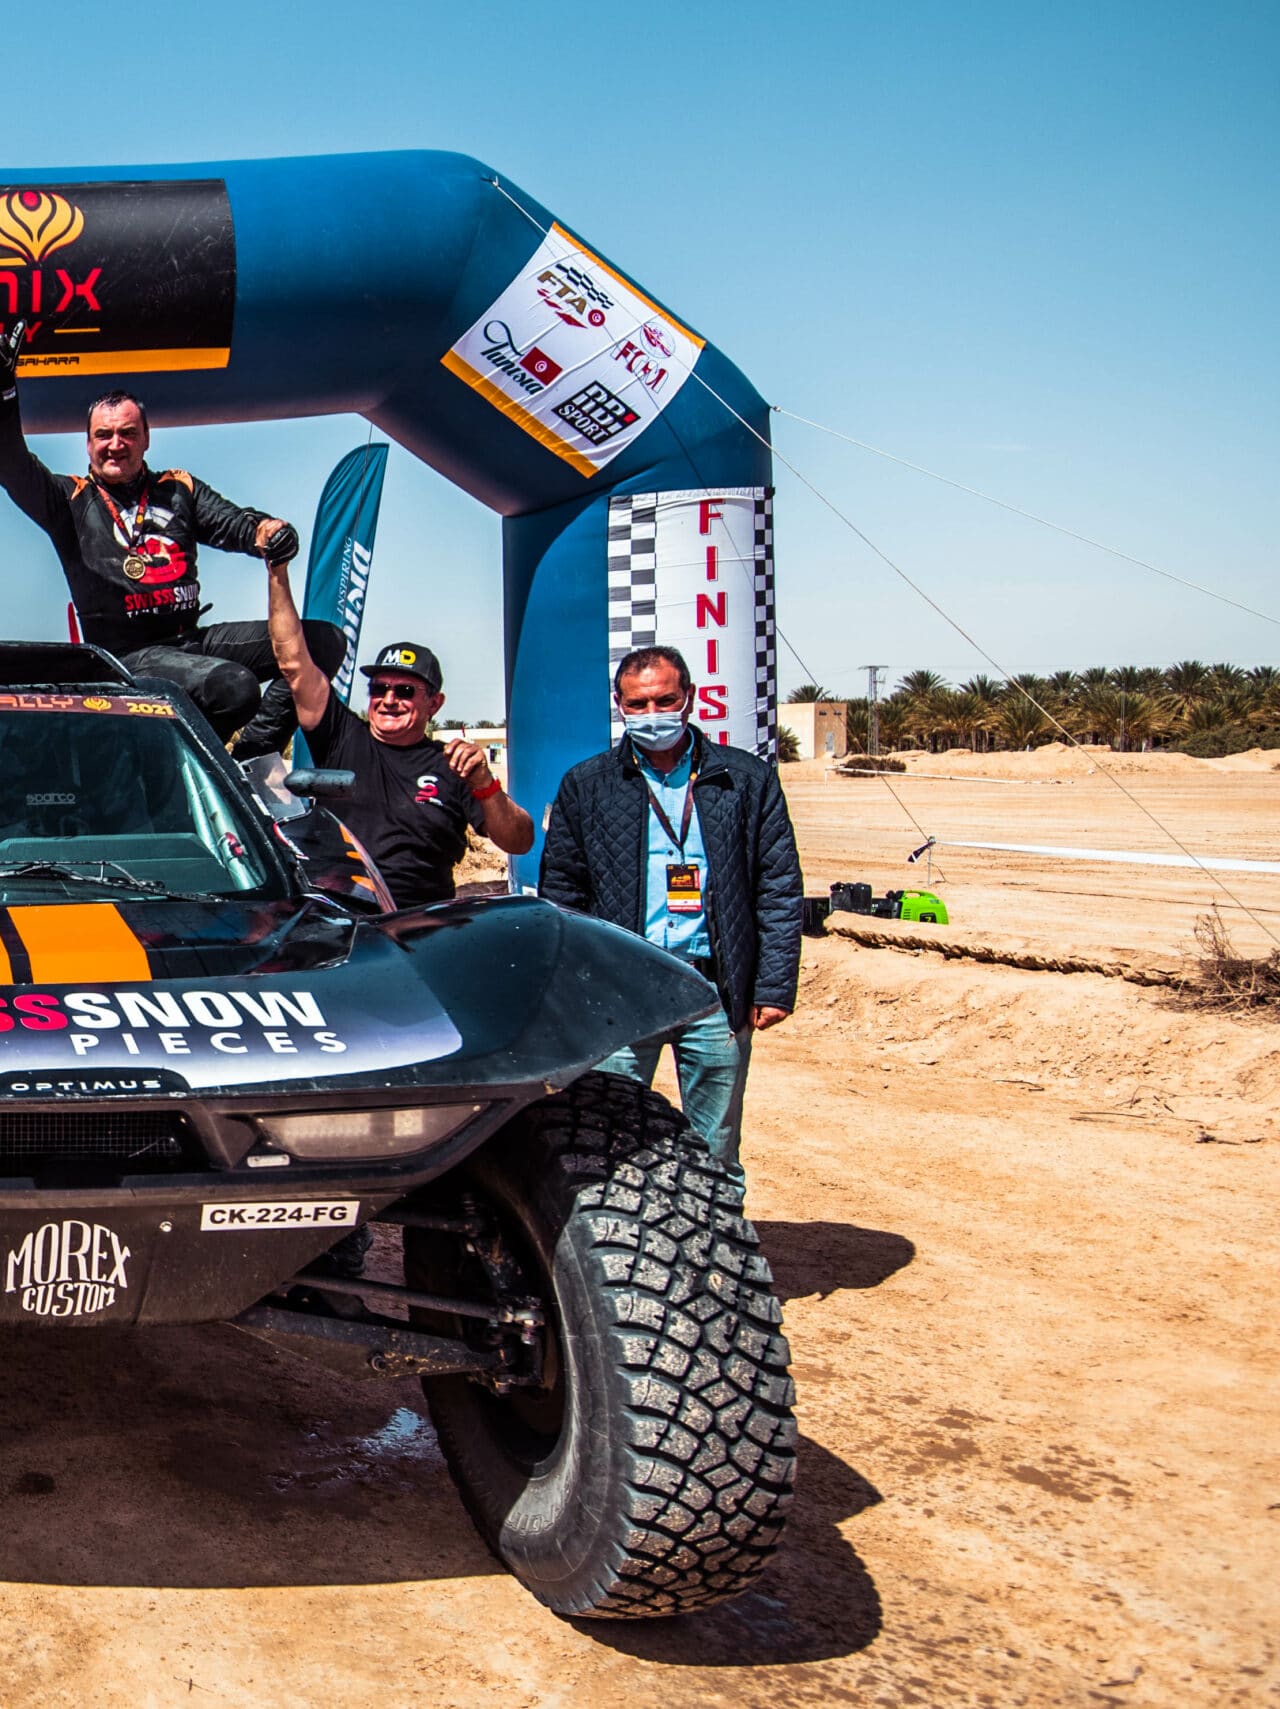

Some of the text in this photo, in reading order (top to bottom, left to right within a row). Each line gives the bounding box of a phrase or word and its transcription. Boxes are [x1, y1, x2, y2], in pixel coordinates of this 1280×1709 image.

[537, 270, 588, 315] FTA
[16, 356, 80, 368] SAHARA
[480, 319, 545, 396] Tunisia
[558, 403, 609, 442] SPORT
[336, 535, 353, 617] INSPIRING
[127, 701, 174, 716] 2021
[26, 792, 75, 804] sparco
[69, 1031, 348, 1056] PIECES
[11, 1078, 161, 1092] OPTIMUS
[208, 1205, 349, 1226] CK-224-FG
[5, 1219, 132, 1293] MOREX
[21, 1281, 116, 1317] CUSTOM
